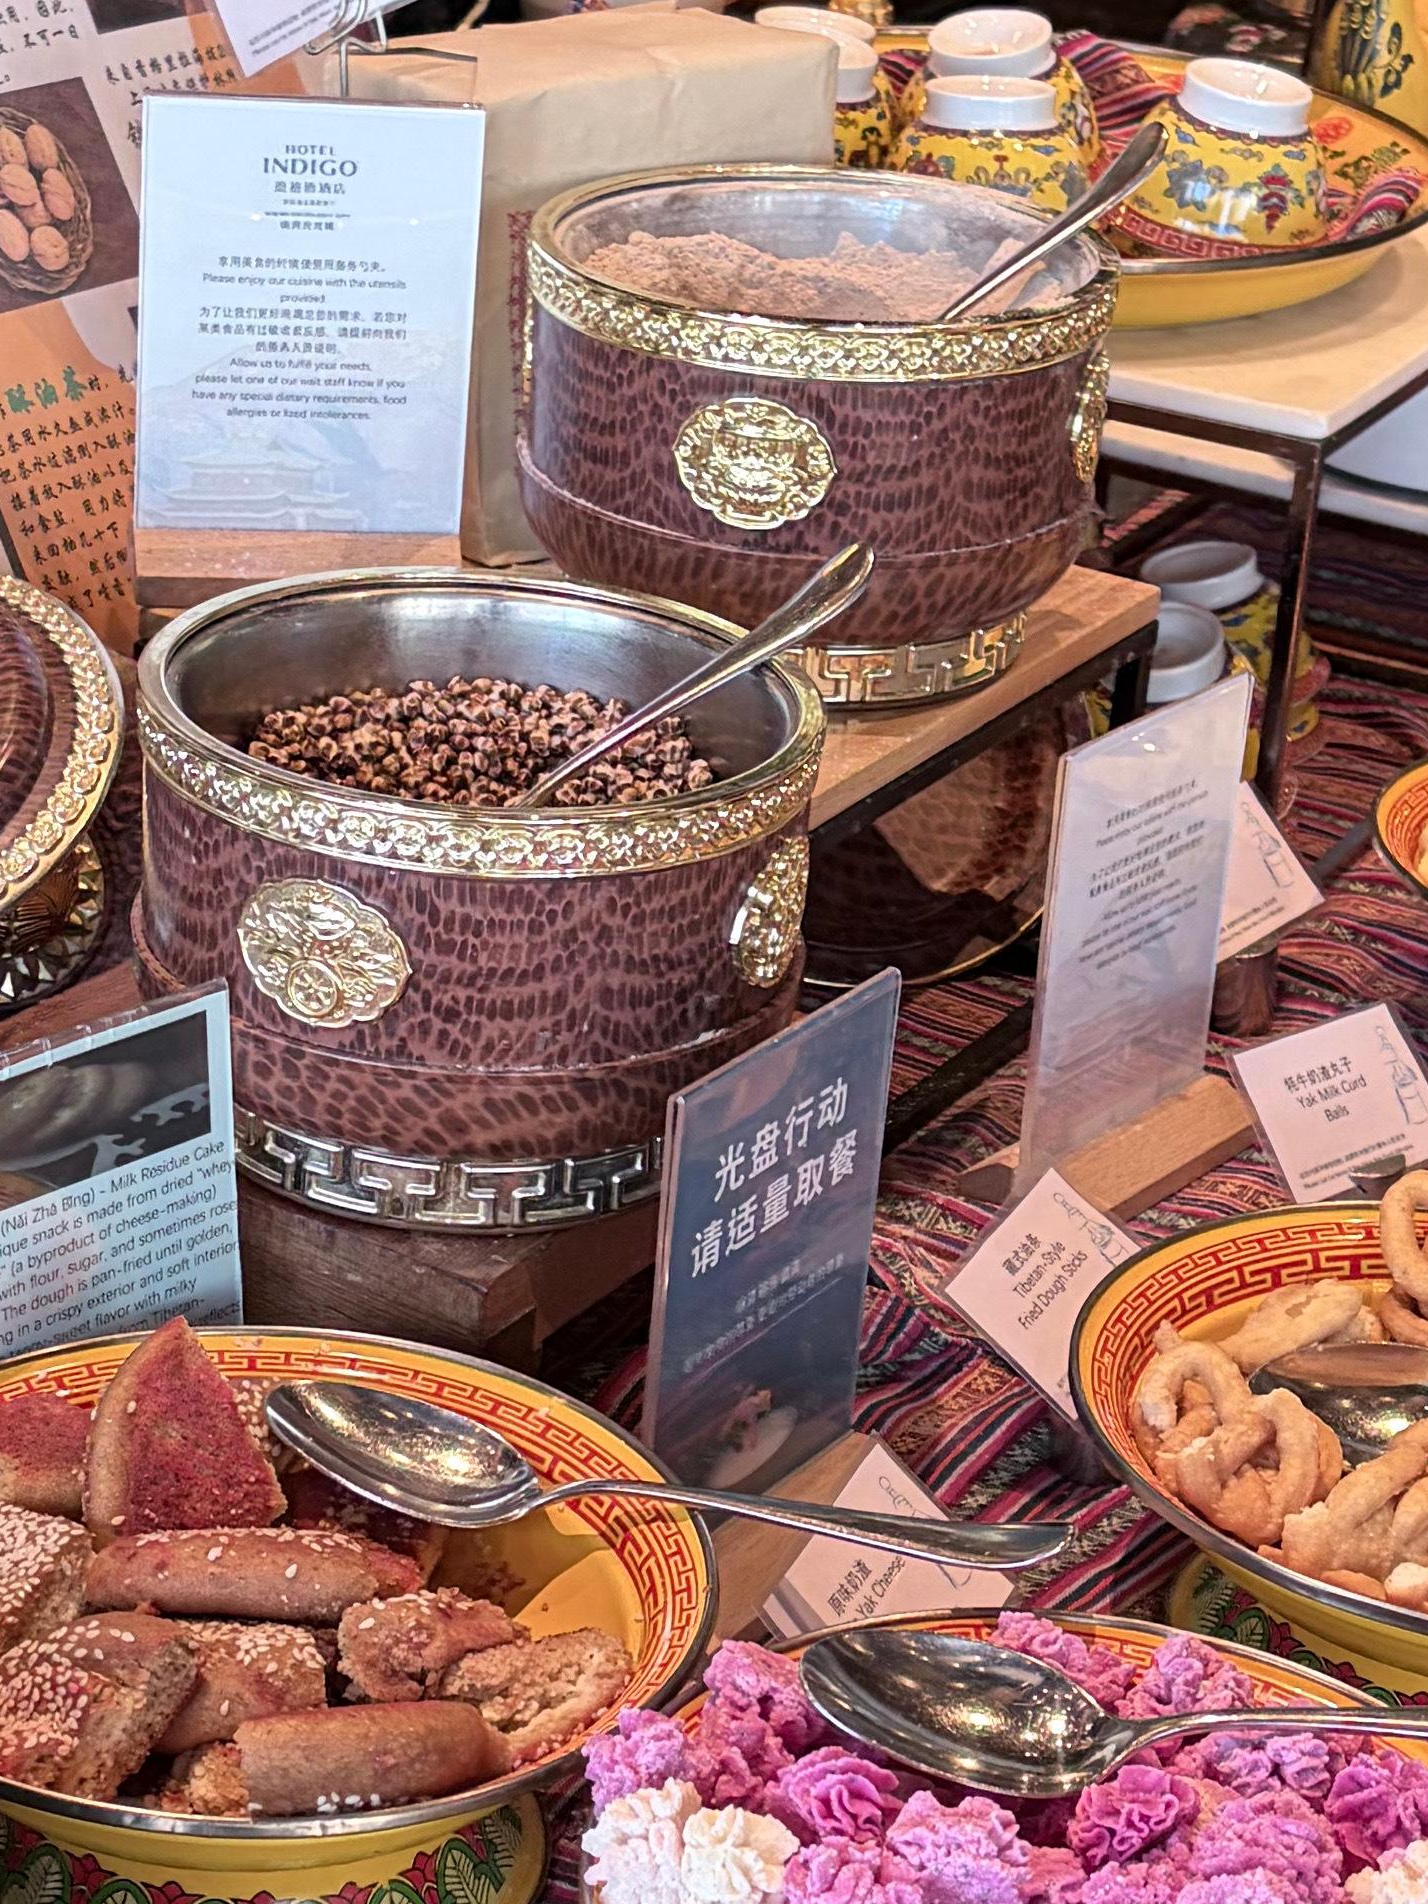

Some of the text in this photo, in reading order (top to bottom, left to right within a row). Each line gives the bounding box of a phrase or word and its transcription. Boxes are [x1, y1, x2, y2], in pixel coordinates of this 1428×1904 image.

[263, 157, 358, 177] INDIGO
[285, 145, 336, 156] HOTEL
[203, 273, 235, 285] Please
[238, 275, 265, 287] enjoy
[325, 278, 347, 288] with
[349, 278, 367, 289] the
[192, 389, 216, 400] have
[195, 374, 229, 384] please
[1283, 1056, 1353, 1094] 牦牛奶渣丸子
[1296, 1073, 1368, 1110] Yak Milk Curd
[713, 1075, 850, 1205] 光盘行动
[1324, 1104, 1351, 1123] Balls
[110, 1173, 138, 1194] Milk
[141, 1156, 191, 1183] Residue
[194, 1140, 226, 1162] Cake
[11, 1260, 24, 1276] (a
[28, 1231, 95, 1270] byproduct
[98, 1224, 112, 1241] of
[115, 1183, 217, 1234] cheese-making)
[32, 1220, 70, 1246] snack
[73, 1214, 83, 1229] is
[86, 1199, 124, 1224] made
[126, 1187, 158, 1208] from
[161, 1171, 194, 1196] dried
[110, 1238, 136, 1259] and
[138, 1210, 206, 1247] sometimes
[209, 1200, 237, 1218] rose
[690, 1129, 860, 1280] 请适量取餐
[1, 1301, 27, 1322] The
[30, 1284, 75, 1312] dough
[77, 1278, 88, 1292] is
[91, 1251, 152, 1289] pan-fried
[155, 1238, 182, 1261] until
[185, 1223, 233, 1252] golden,
[17, 1320, 31, 1335] in
[45, 1303, 84, 1327] crispy
[87, 1280, 136, 1310] exterior
[139, 1267, 163, 1289] and
[166, 1255, 191, 1277] soft
[193, 1240, 238, 1267] interior
[1011, 1239, 1067, 1300] Tibetan-Style
[1016, 1248, 1089, 1330] Fried Dough Sticks
[95, 1277, 197, 1328] flavor with milky
[856, 1555, 907, 1620] Yak Cheese
